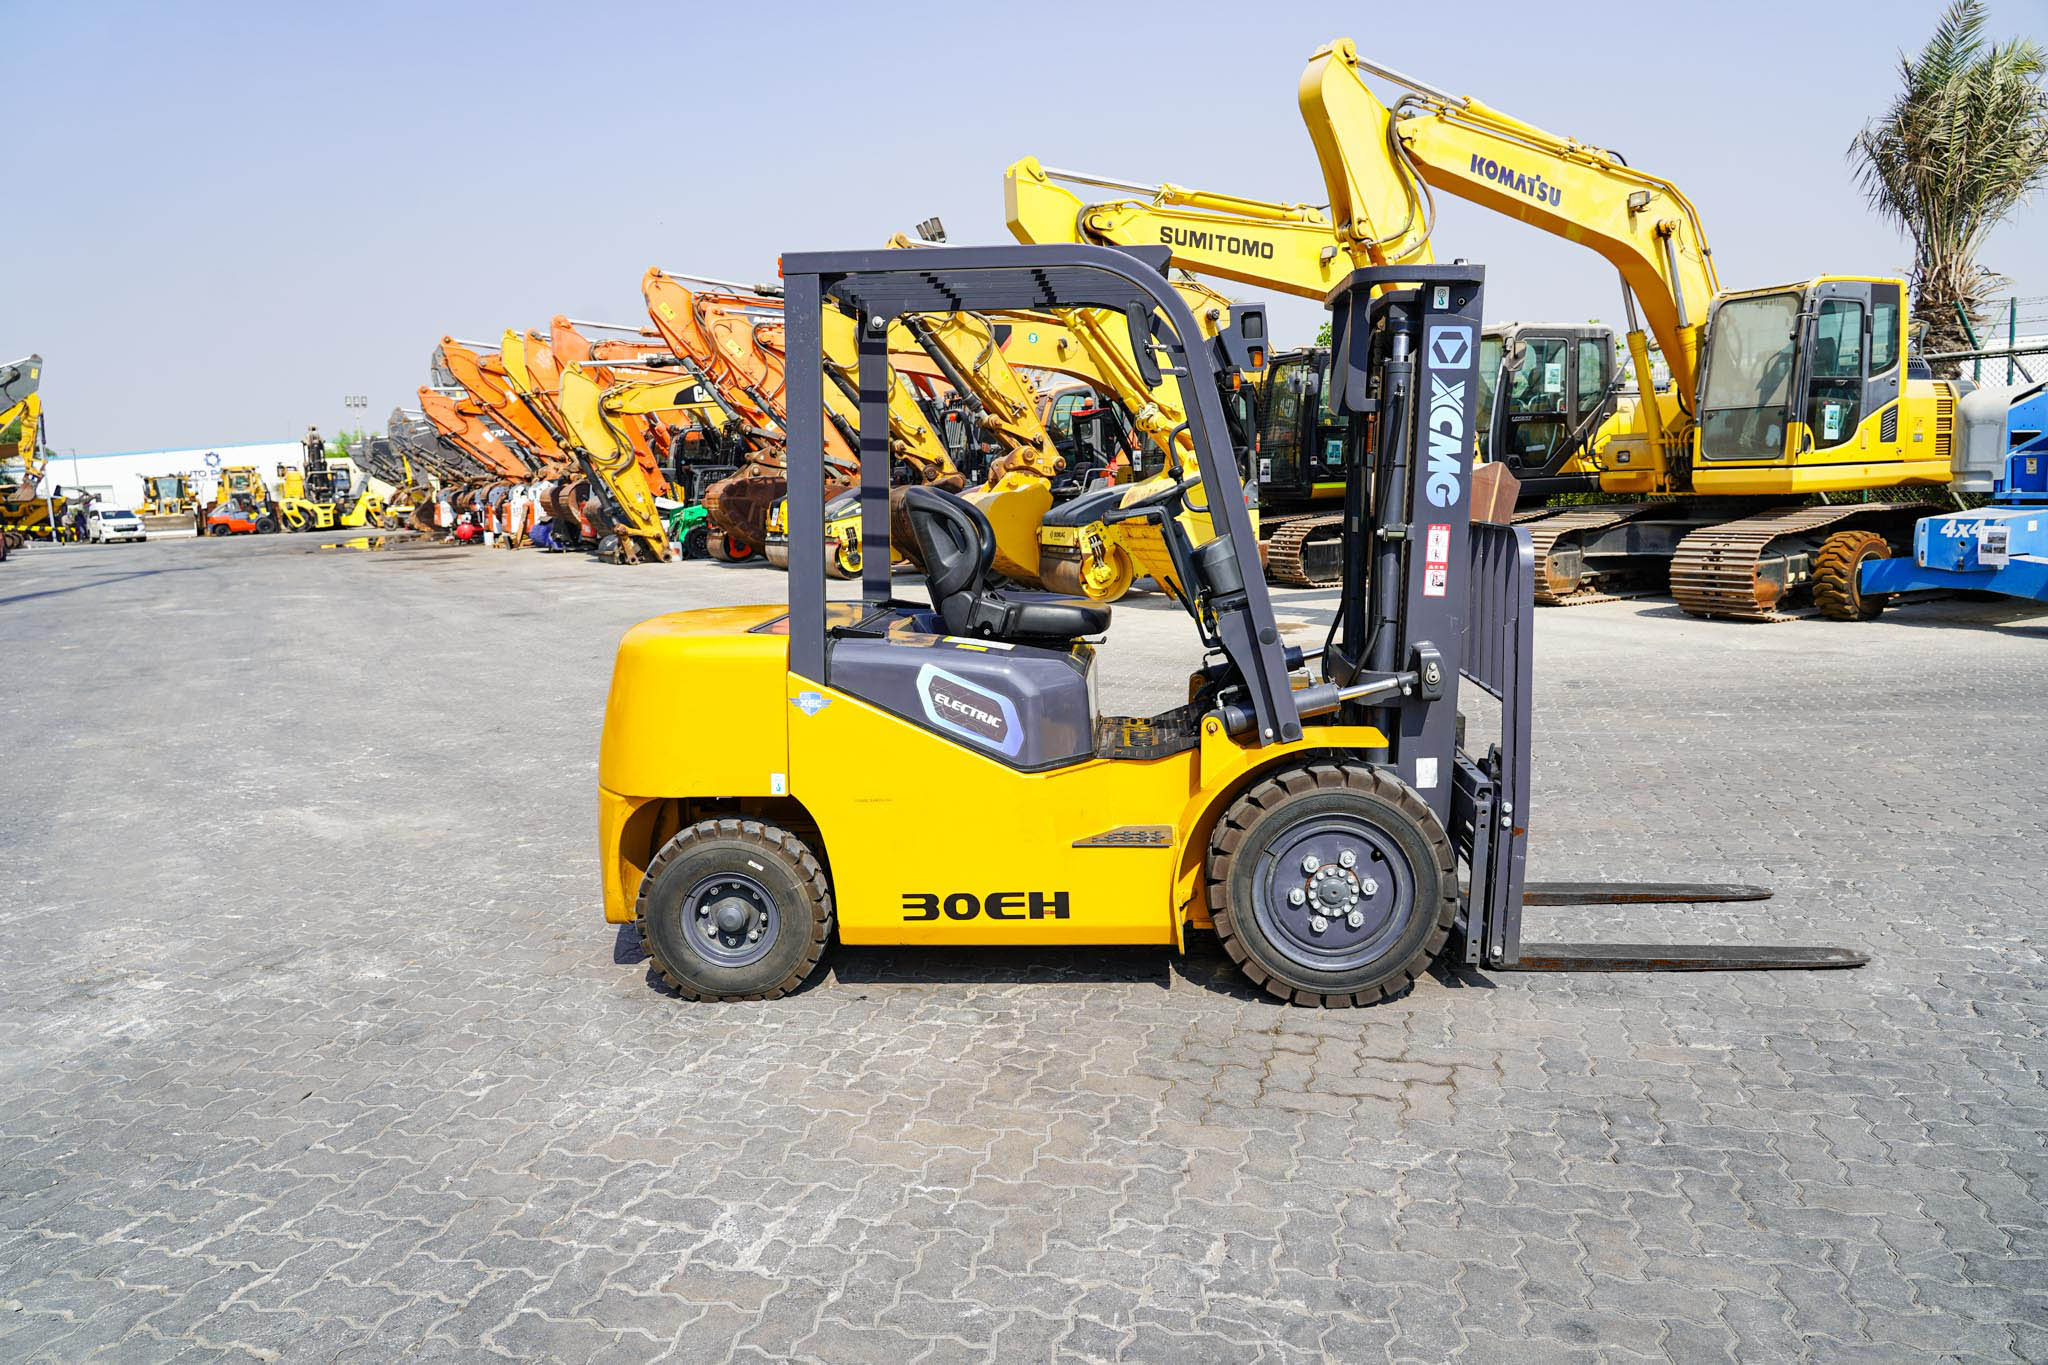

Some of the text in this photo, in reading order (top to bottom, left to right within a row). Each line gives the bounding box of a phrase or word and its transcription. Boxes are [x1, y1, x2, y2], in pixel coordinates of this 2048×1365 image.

[1470, 153, 1562, 207] KOMATSU
[1160, 226, 1274, 259] SUMITOMO
[1426, 372, 1465, 508] XCMG
[1940, 519, 1985, 538] 4x4
[934, 692, 1002, 728] ELECTRIC
[902, 892, 1070, 921] 30EH
